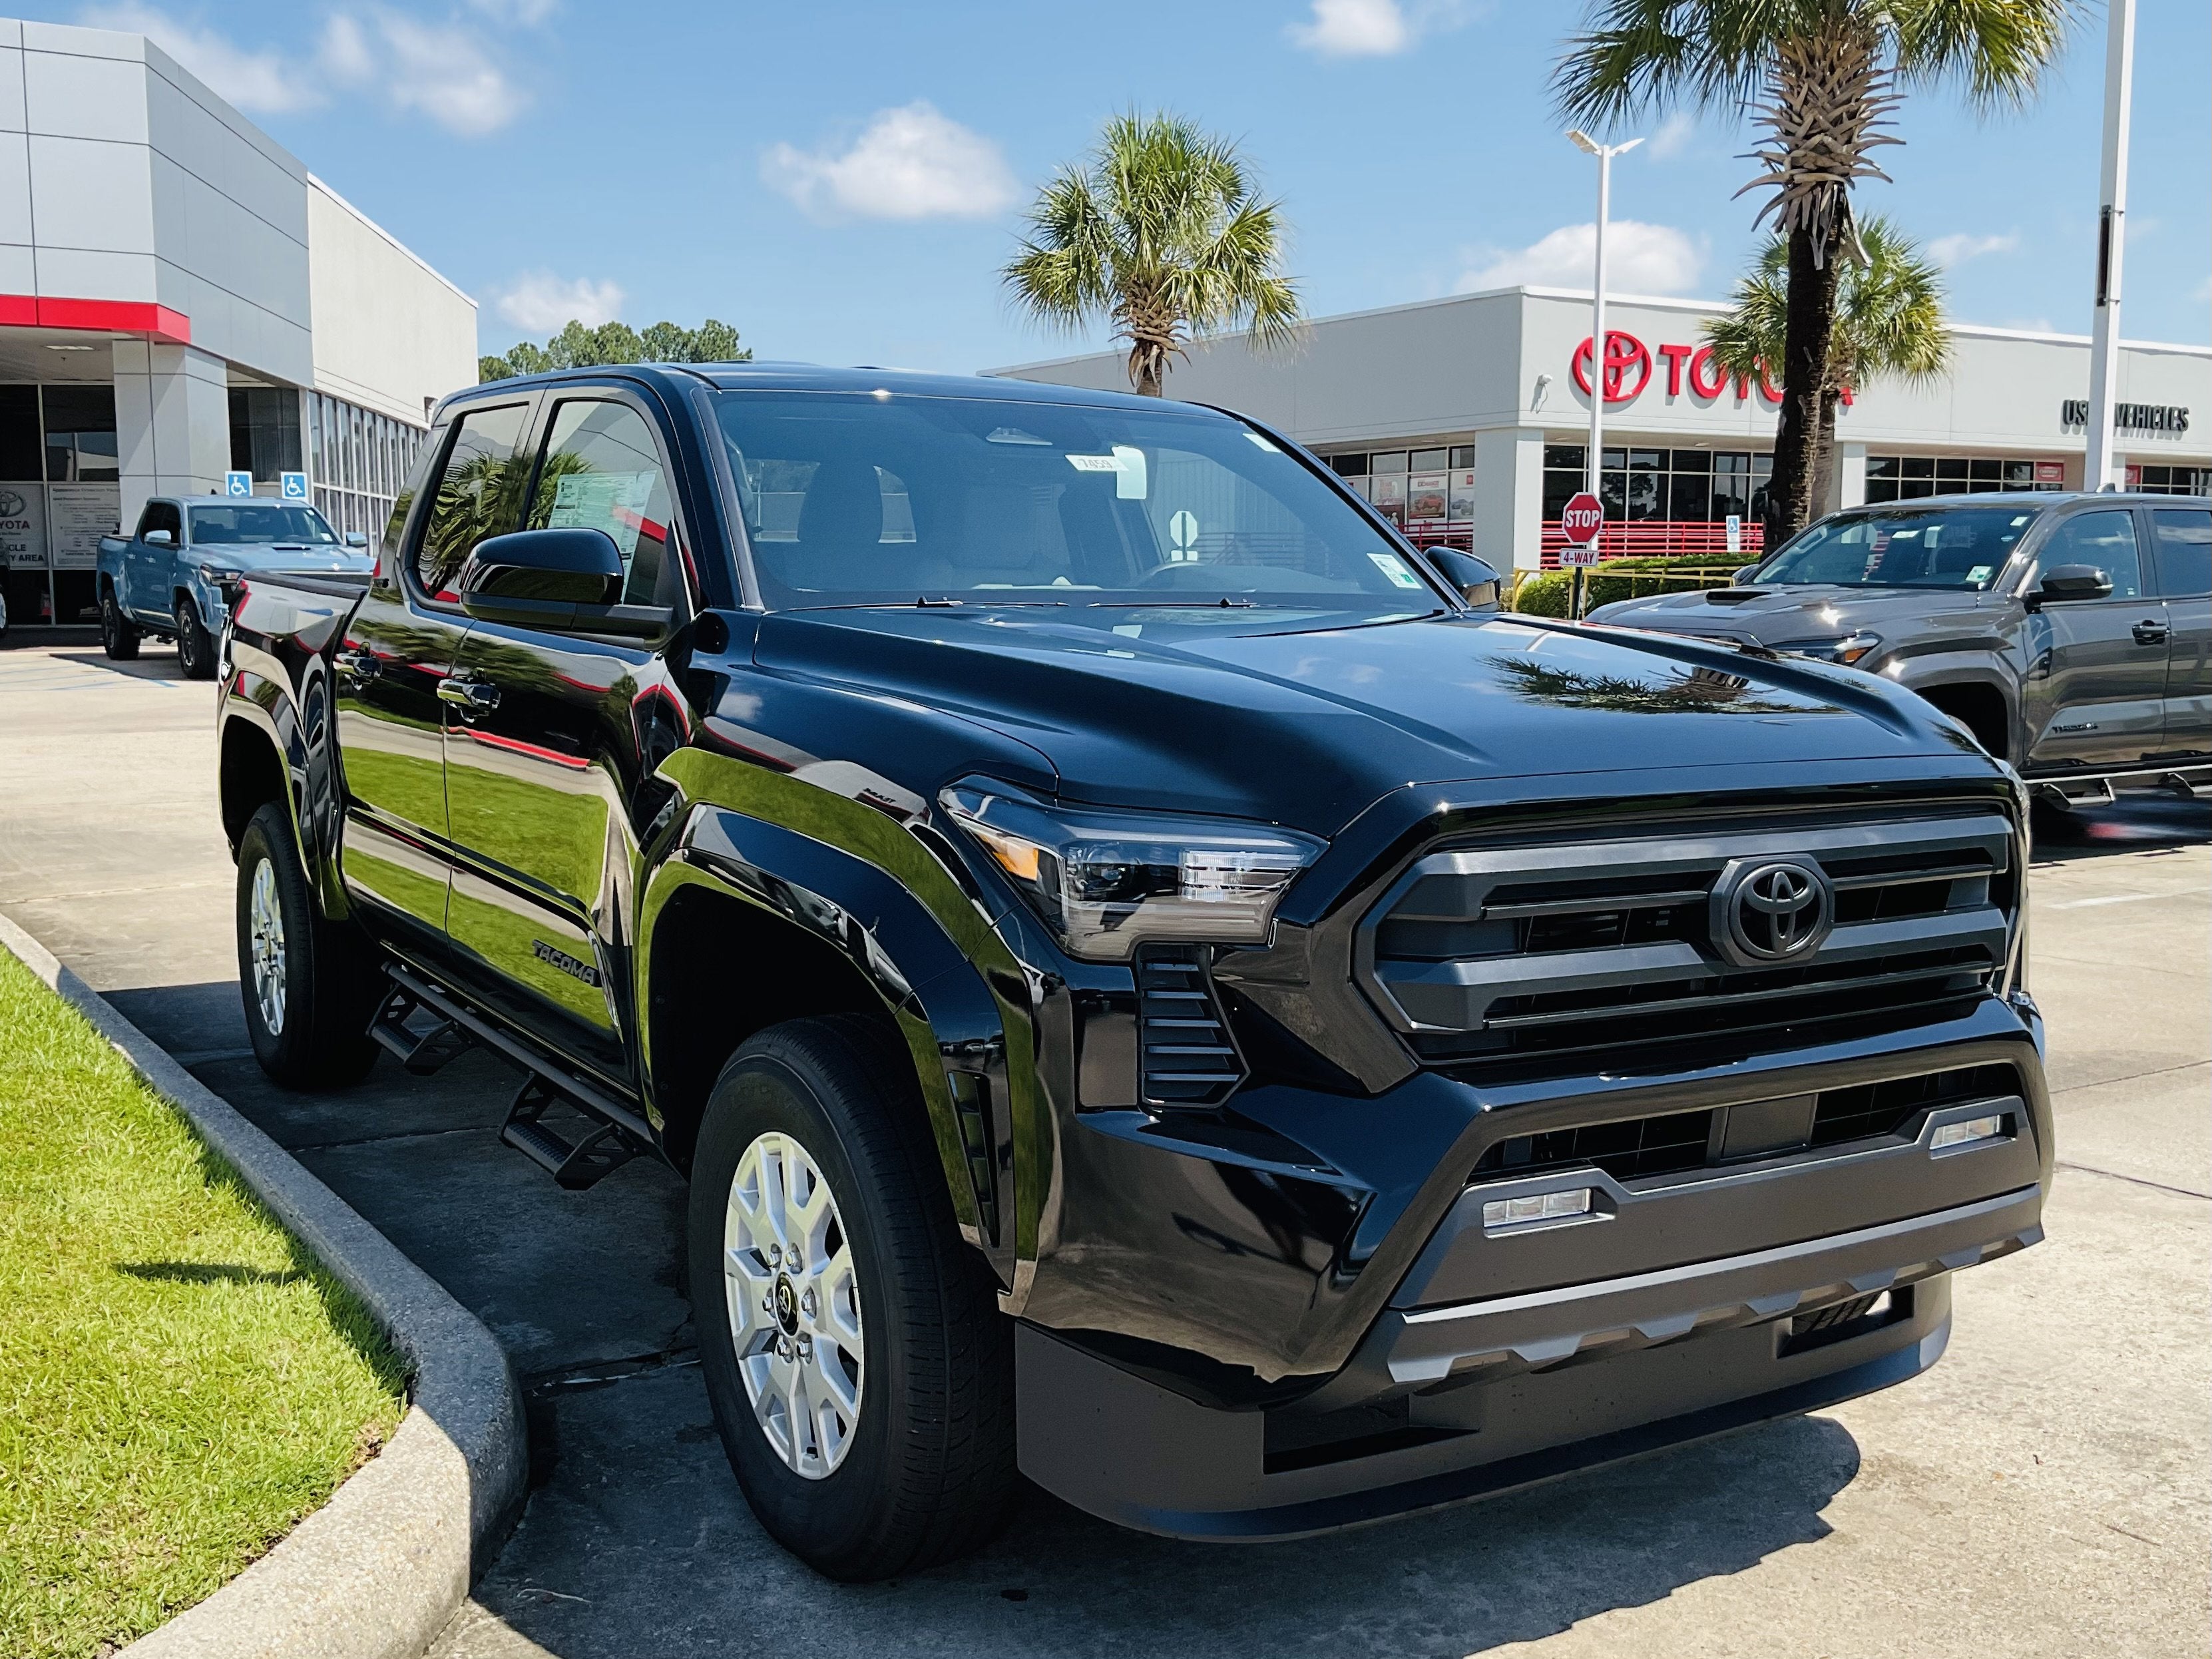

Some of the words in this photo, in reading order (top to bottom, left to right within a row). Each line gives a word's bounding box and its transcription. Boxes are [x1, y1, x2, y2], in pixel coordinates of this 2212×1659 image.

[2063, 399, 2089, 426] US
[2114, 402, 2189, 432] VEHICLES
[1565, 509, 1600, 528] STOP
[1563, 552, 1595, 565] 4-WAY
[532, 939, 598, 987] TACOMA
